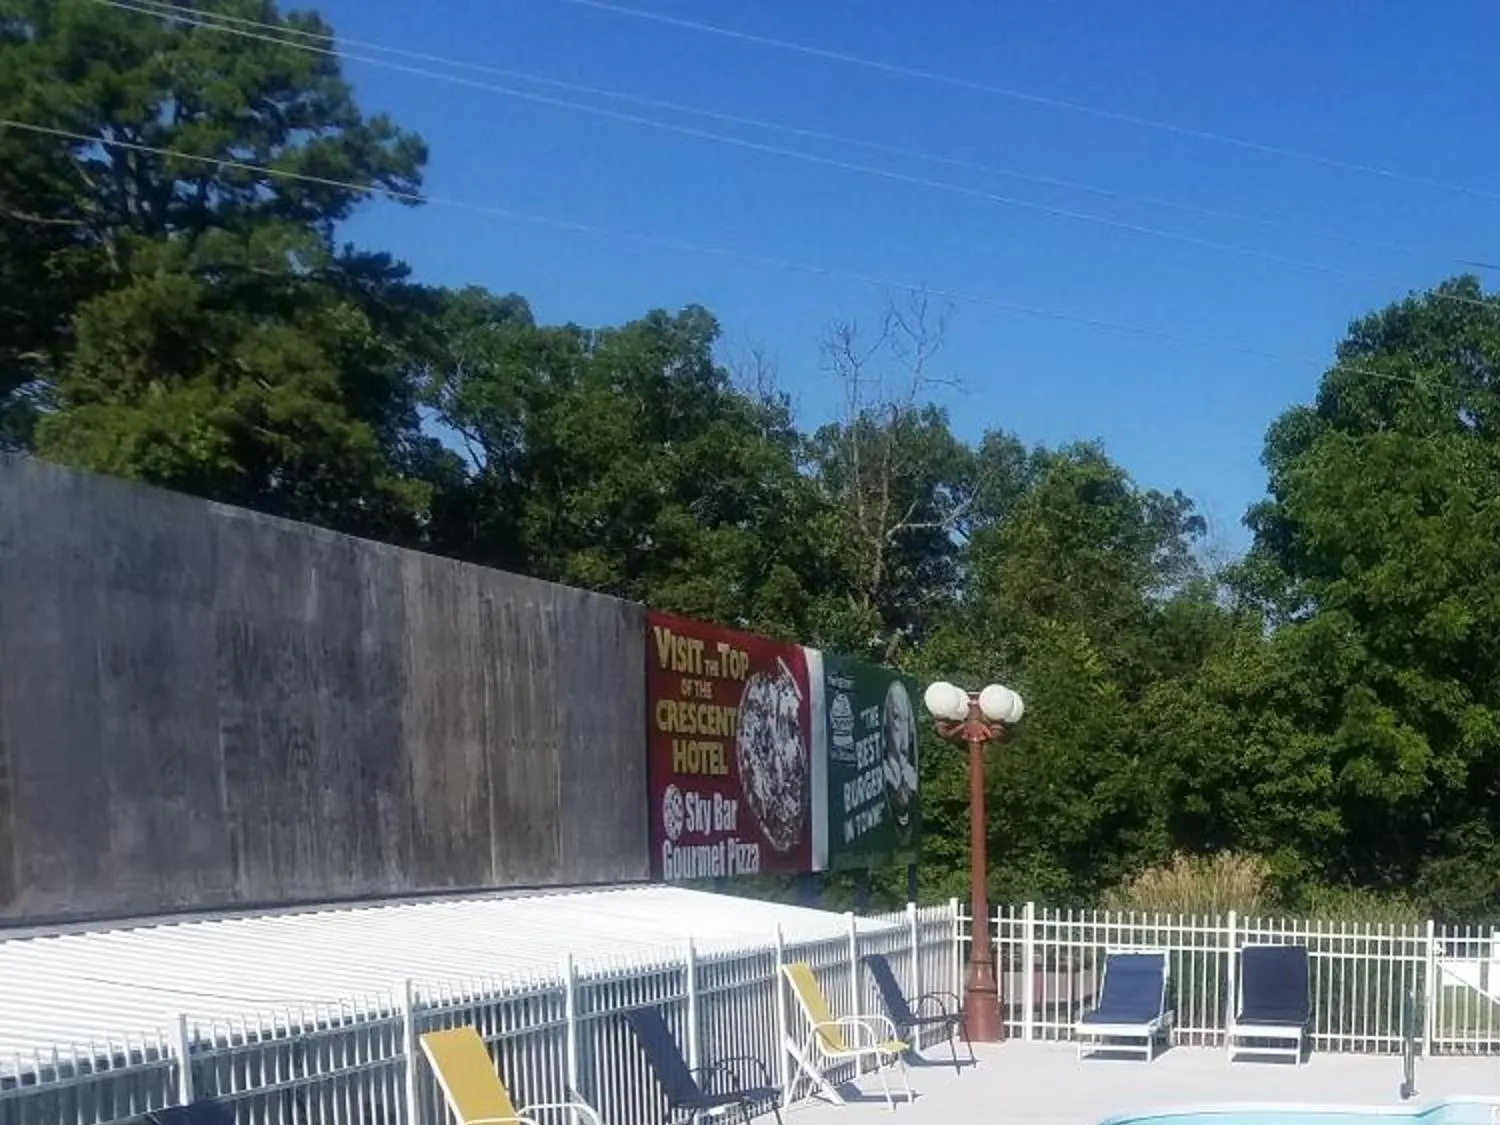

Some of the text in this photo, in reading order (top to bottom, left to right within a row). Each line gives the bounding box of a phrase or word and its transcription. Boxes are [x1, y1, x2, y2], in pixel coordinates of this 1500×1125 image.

[654, 626, 749, 681] VISIT THE TOP
[693, 680, 713, 699] THE
[656, 699, 737, 737] CRESCENT
[672, 739, 729, 775] HOTEL
[855, 731, 881, 770] BEST
[843, 766, 883, 815] BURGER
[685, 791, 738, 836] Sky Bar
[663, 837, 759, 881] Gourmet Pizza
